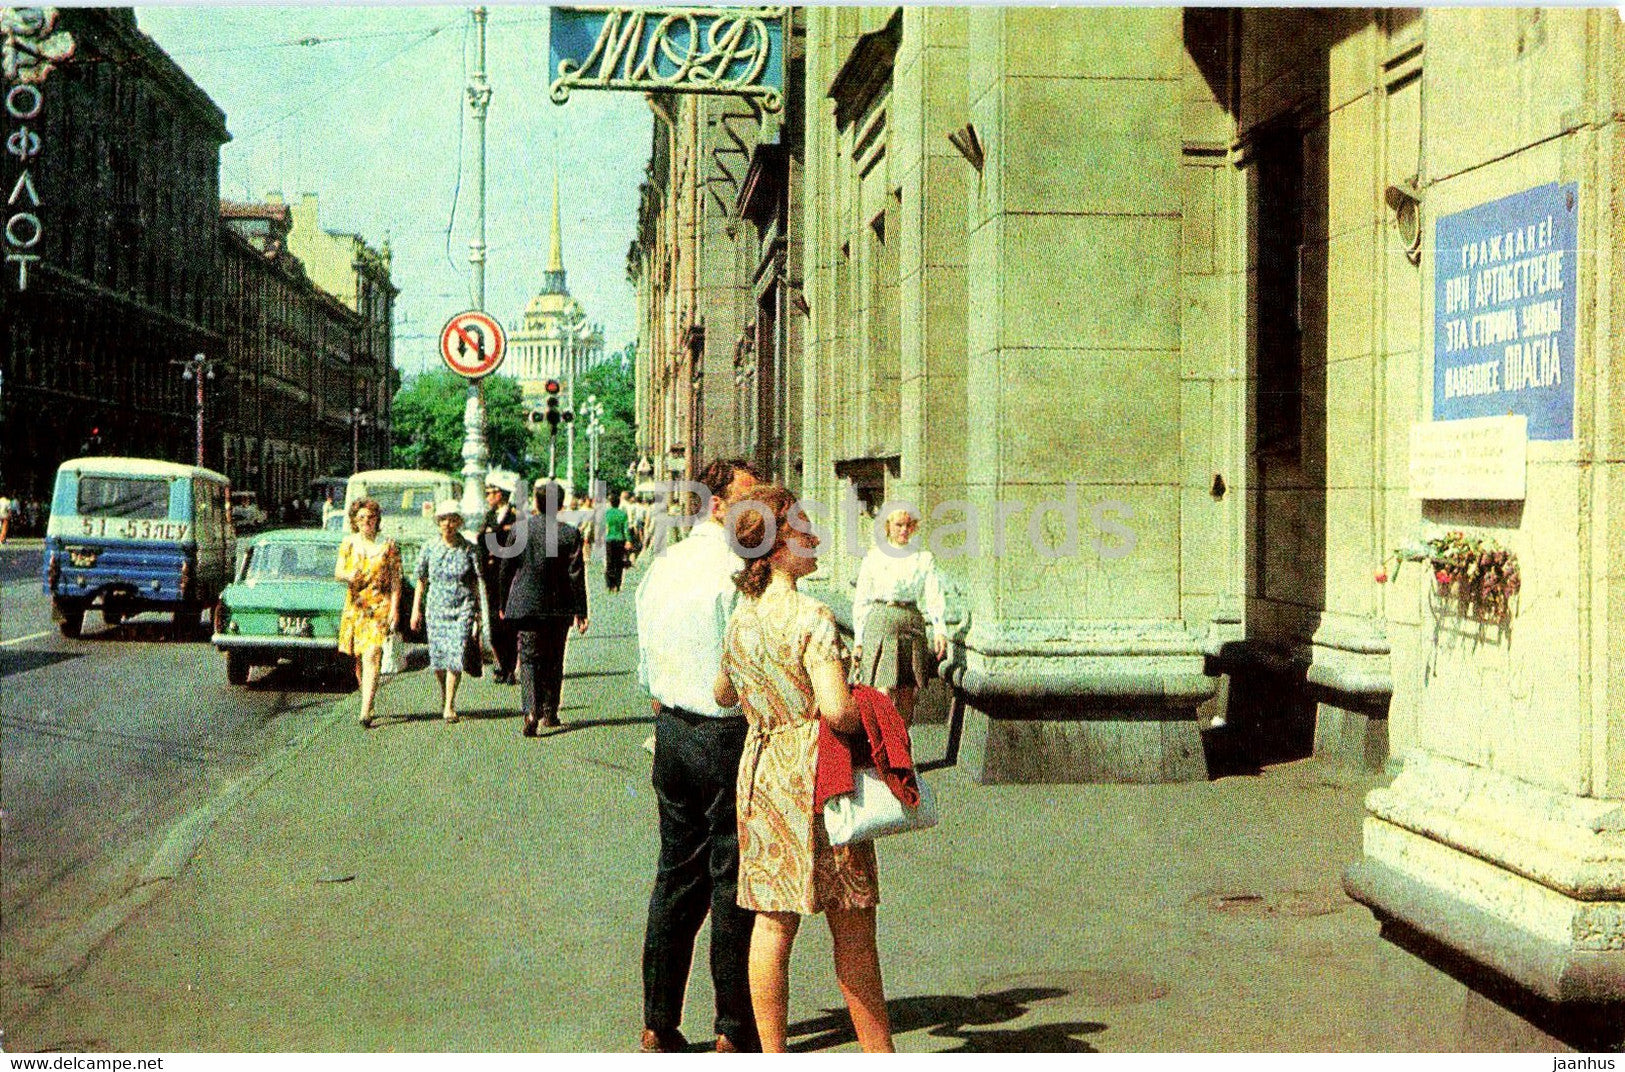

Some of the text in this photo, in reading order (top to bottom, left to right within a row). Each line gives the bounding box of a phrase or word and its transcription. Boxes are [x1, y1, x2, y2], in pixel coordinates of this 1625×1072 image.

[1461, 214, 1552, 270] ГРАЖДАНЕ!
[1445, 275, 1470, 315] ПРИ
[1445, 319, 1469, 353] ЭТА
[1503, 336, 1562, 392] ОПАСНА
